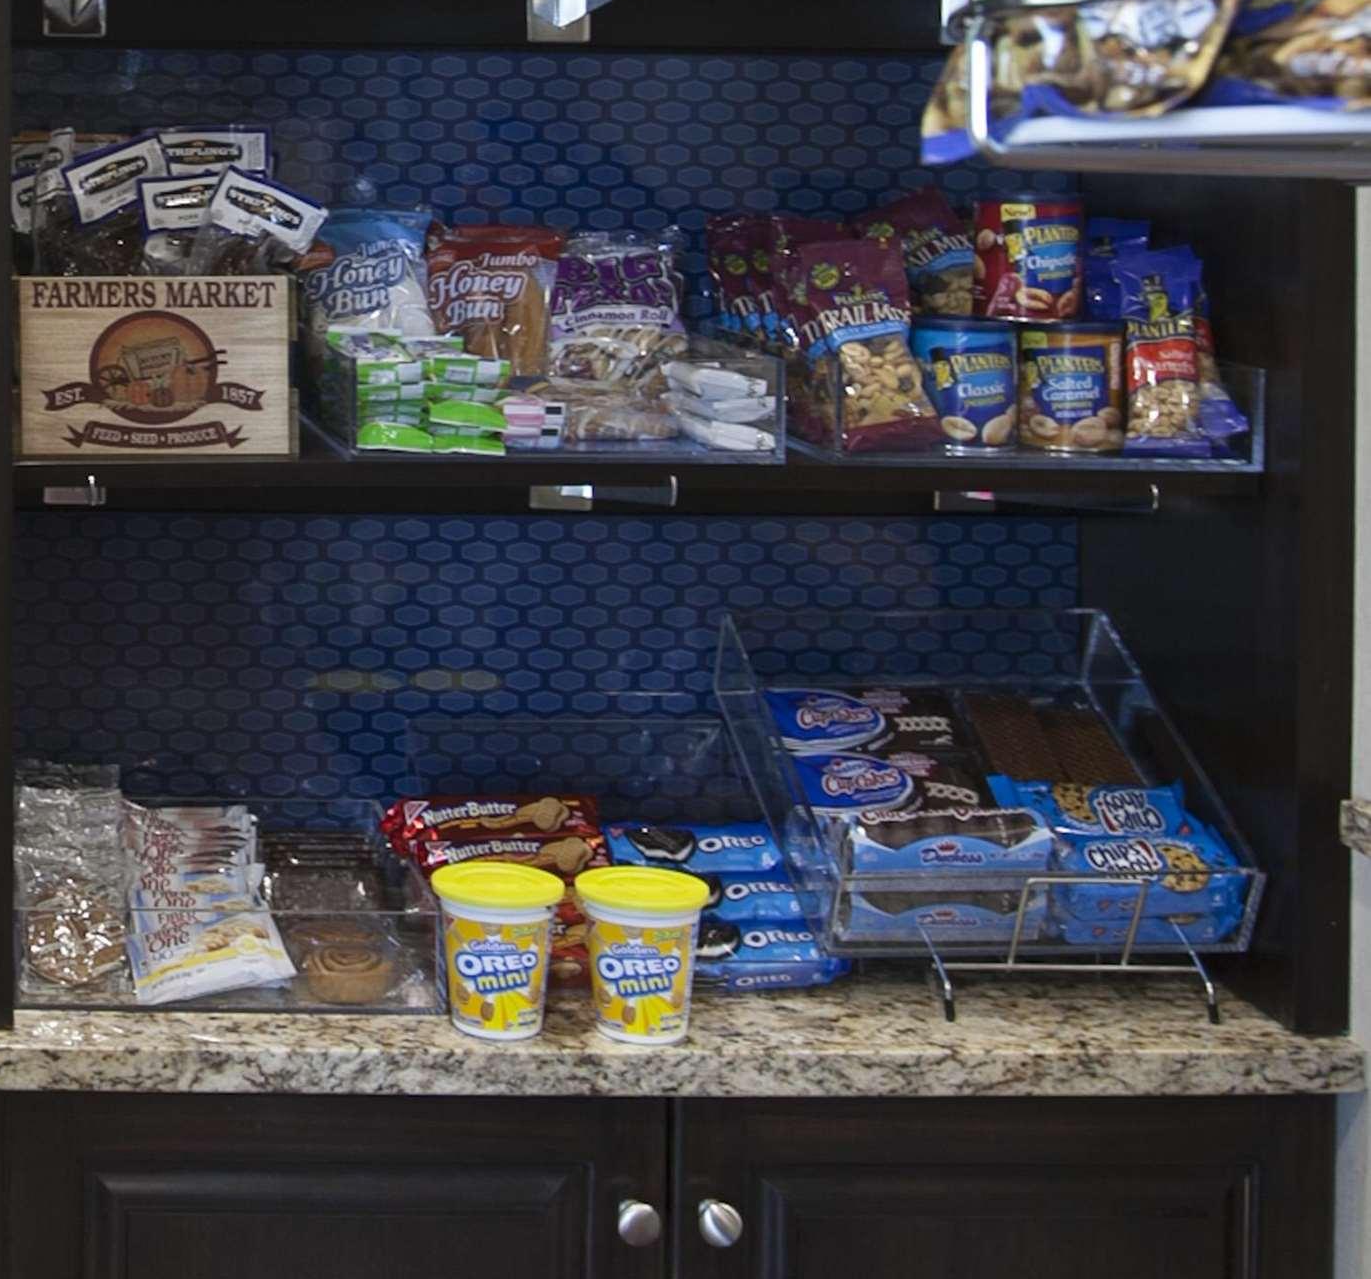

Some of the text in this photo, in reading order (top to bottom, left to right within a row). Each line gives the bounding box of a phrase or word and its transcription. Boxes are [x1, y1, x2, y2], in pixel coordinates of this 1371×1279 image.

[478, 252, 539, 268] Jumbo
[309, 255, 404, 297] Honey
[429, 260, 526, 310] Honey
[31, 281, 277, 309] FARMERS MARKET
[327, 287, 390, 318] Bun
[446, 297, 505, 326] Bun
[565, 308, 669, 327] Cinnamon Roll
[818, 301, 868, 333] TRAIL
[956, 381, 1006, 399] Classic
[1046, 376, 1093, 390] Salted
[54, 388, 86, 407] EST.
[221, 388, 257, 406] 1857
[1041, 386, 1101, 402] Caramel
[91, 426, 218, 445] FEED SEED PRODUCE
[420, 800, 518, 825] Nutter Butter
[443, 839, 541, 864] Nutter Butter
[697, 834, 767, 853] OREO
[1087, 839, 1141, 868] Chips
[921, 848, 983, 865] Duchess
[723, 880, 795, 901] OREO
[470, 939, 517, 953] Golden
[742, 929, 814, 948] OREO
[611, 943, 659, 956] Golden
[456, 952, 538, 977] OREO
[597, 956, 680, 980] OREO
[476, 970, 529, 993] mini
[617, 973, 671, 996] mini
